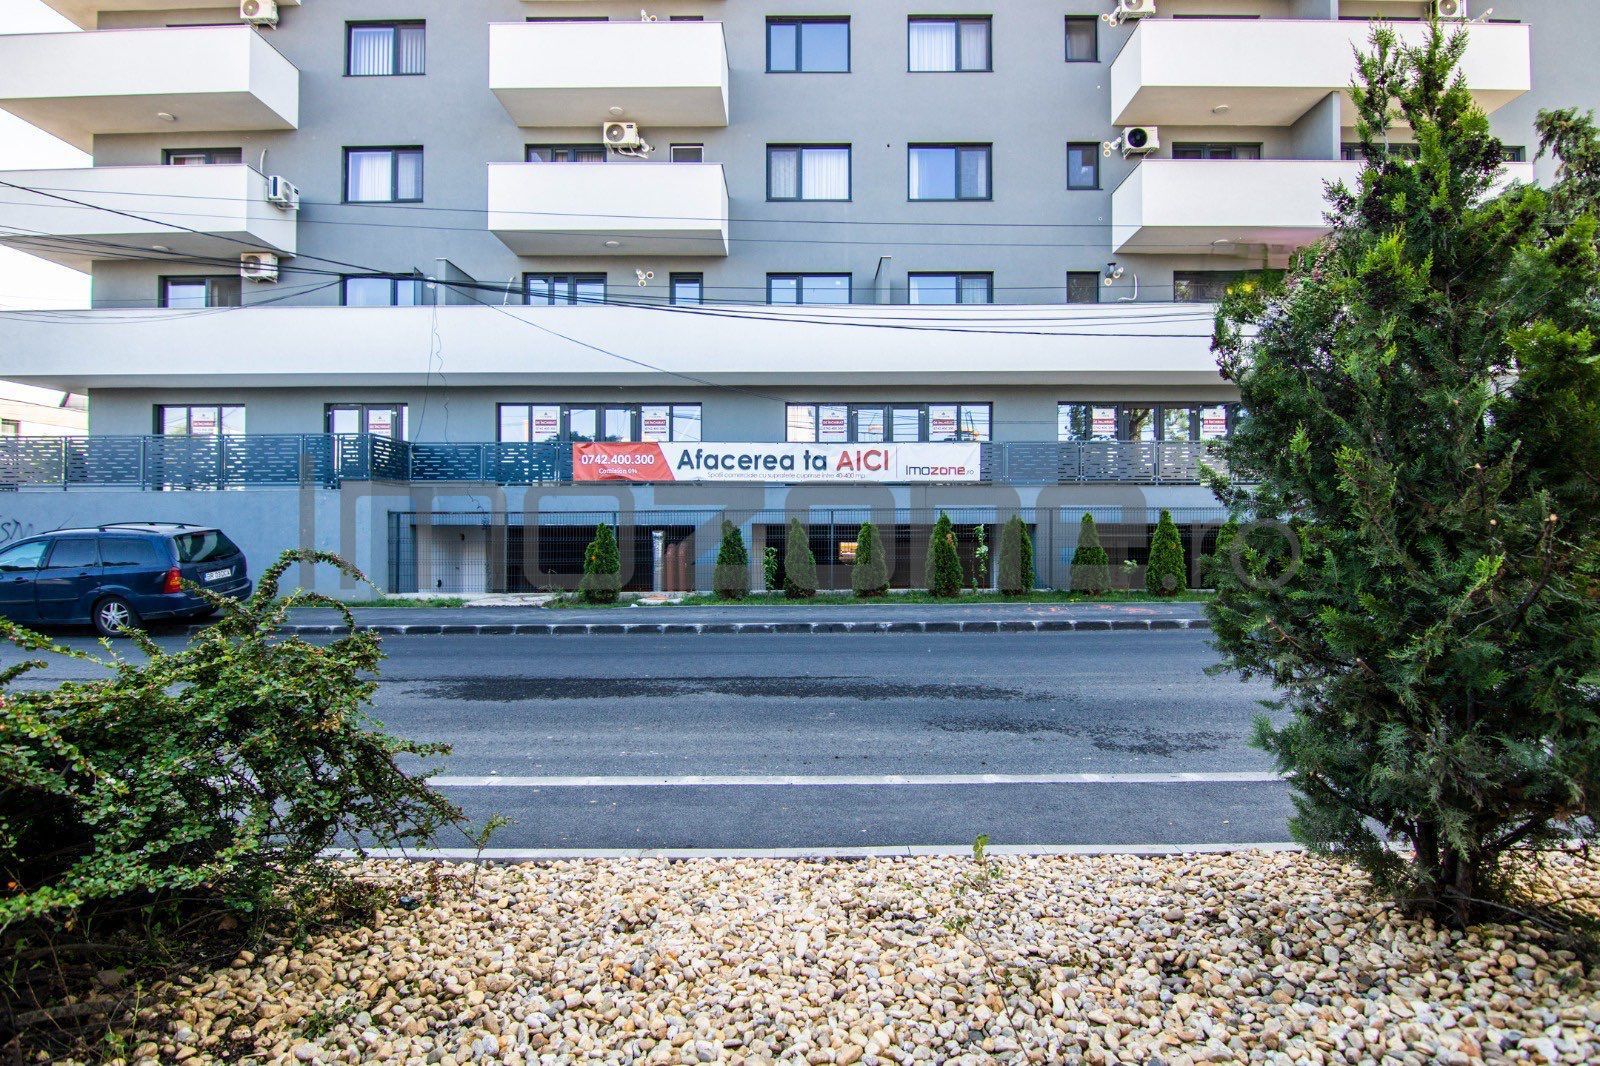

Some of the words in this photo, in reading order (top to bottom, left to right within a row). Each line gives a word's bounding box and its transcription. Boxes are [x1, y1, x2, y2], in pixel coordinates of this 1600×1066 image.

[581, 454, 655, 465] 0742.400.300
[677, 448, 795, 471] Afacerea
[803, 449, 828, 471] ta
[836, 449, 889, 472] AICI
[598, 467, 627, 475] Comision
